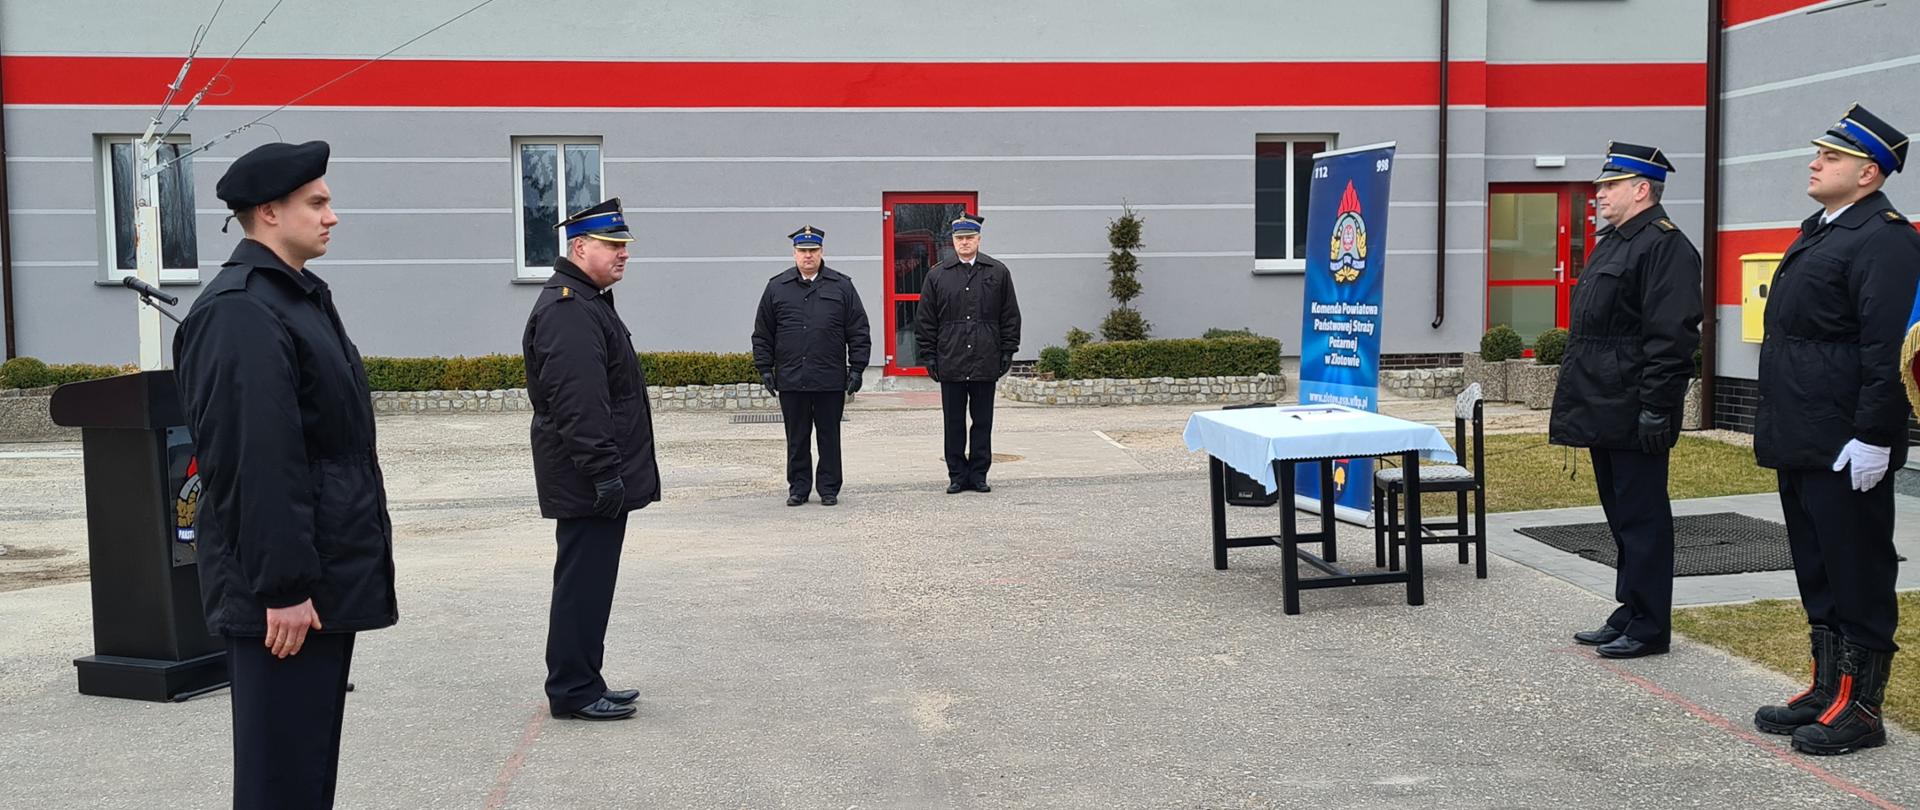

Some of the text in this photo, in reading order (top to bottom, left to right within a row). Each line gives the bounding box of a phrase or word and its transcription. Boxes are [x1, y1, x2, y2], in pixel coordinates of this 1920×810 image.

[1376, 158, 1389, 172] 998
[1315, 166, 1328, 179] 112
[1311, 302, 1379, 315] Komenda Powiatowa
[1314, 318, 1374, 336] Państwowej Straży
[1328, 336, 1358, 352] Pożarnej
[1324, 355, 1331, 365] w
